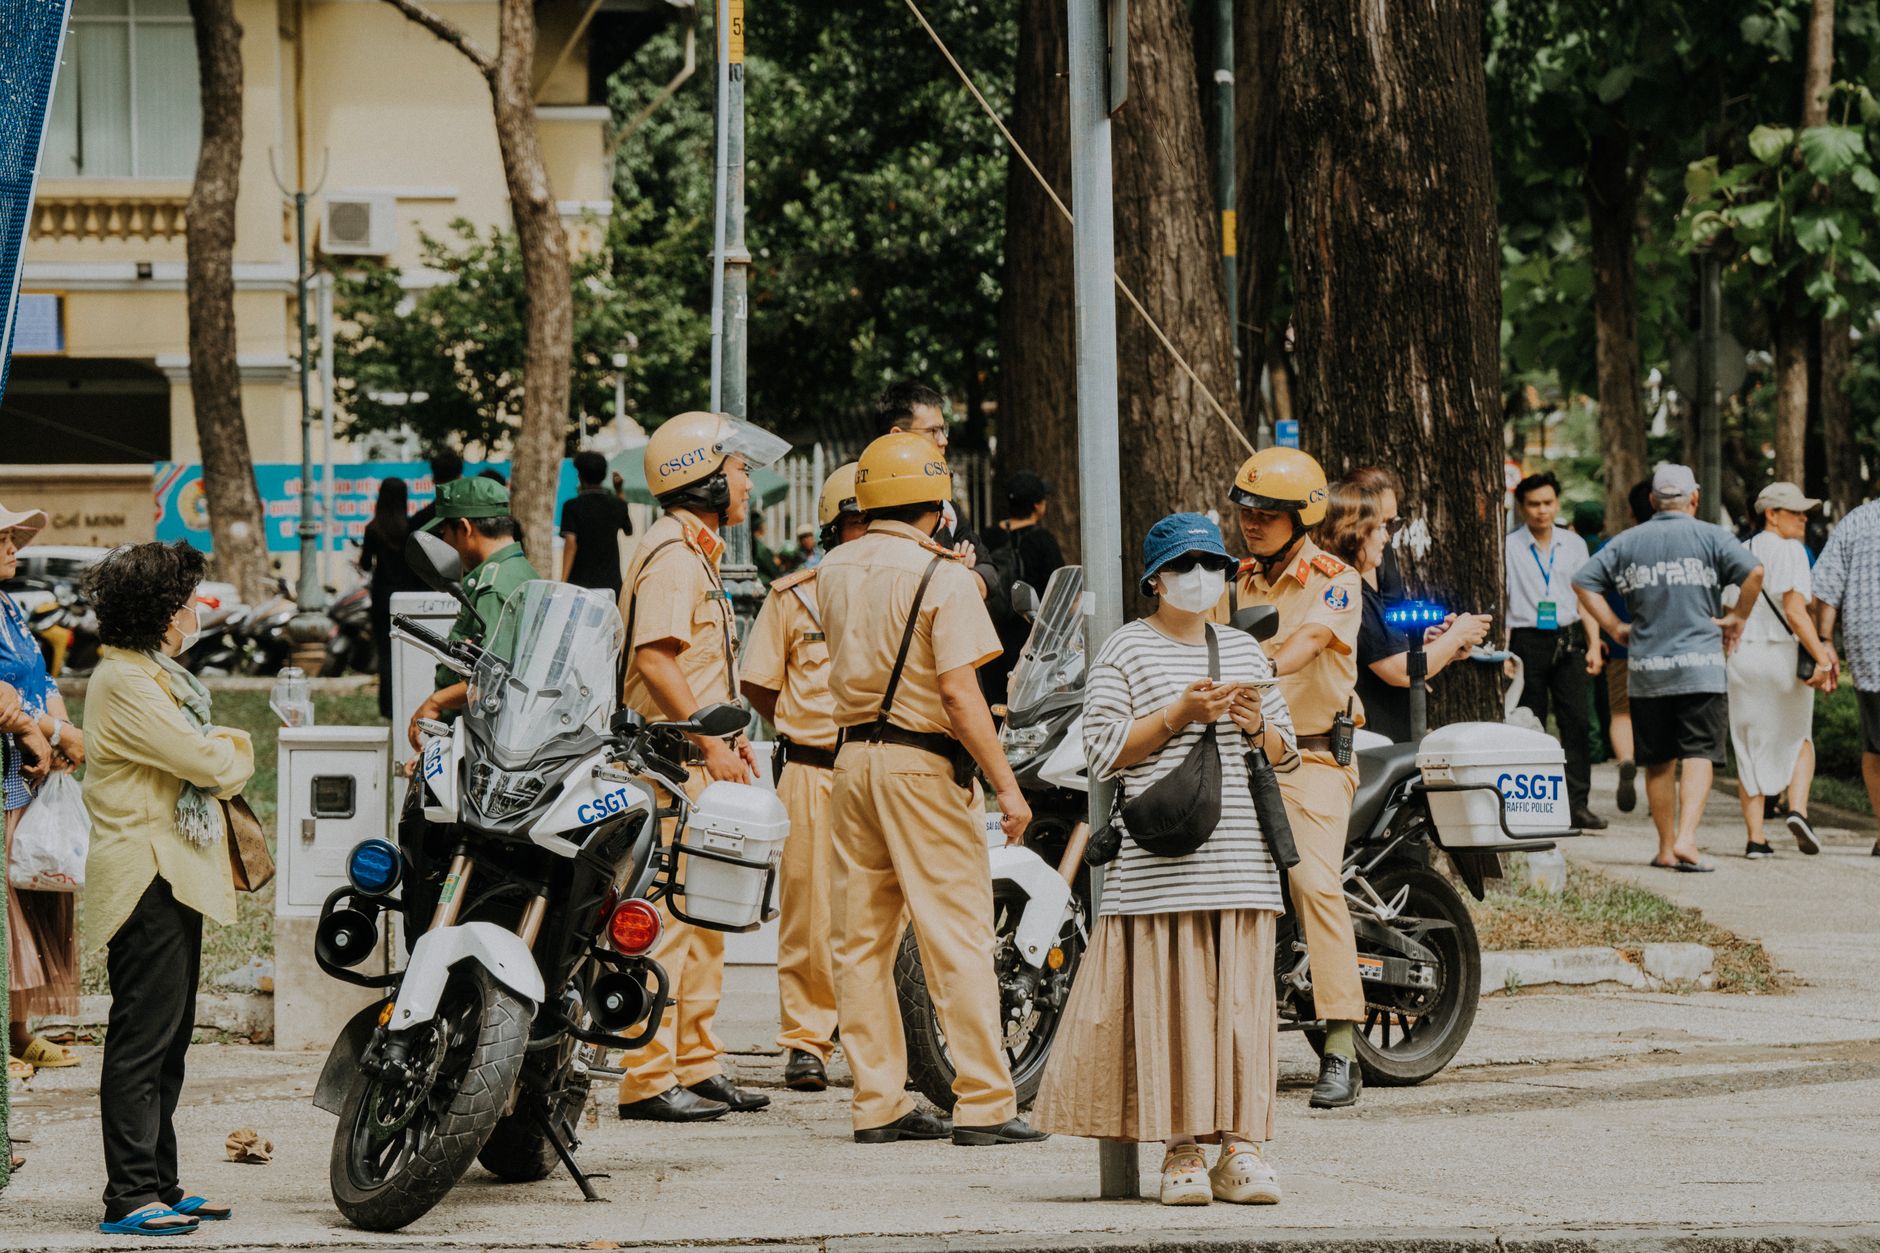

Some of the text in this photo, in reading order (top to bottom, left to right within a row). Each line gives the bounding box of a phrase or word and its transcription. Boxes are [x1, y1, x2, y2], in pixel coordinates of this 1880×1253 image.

[659, 447, 705, 477] CSGT
[1496, 772, 1563, 801] C.S.G.T
[1531, 802, 1554, 814] POLICE
